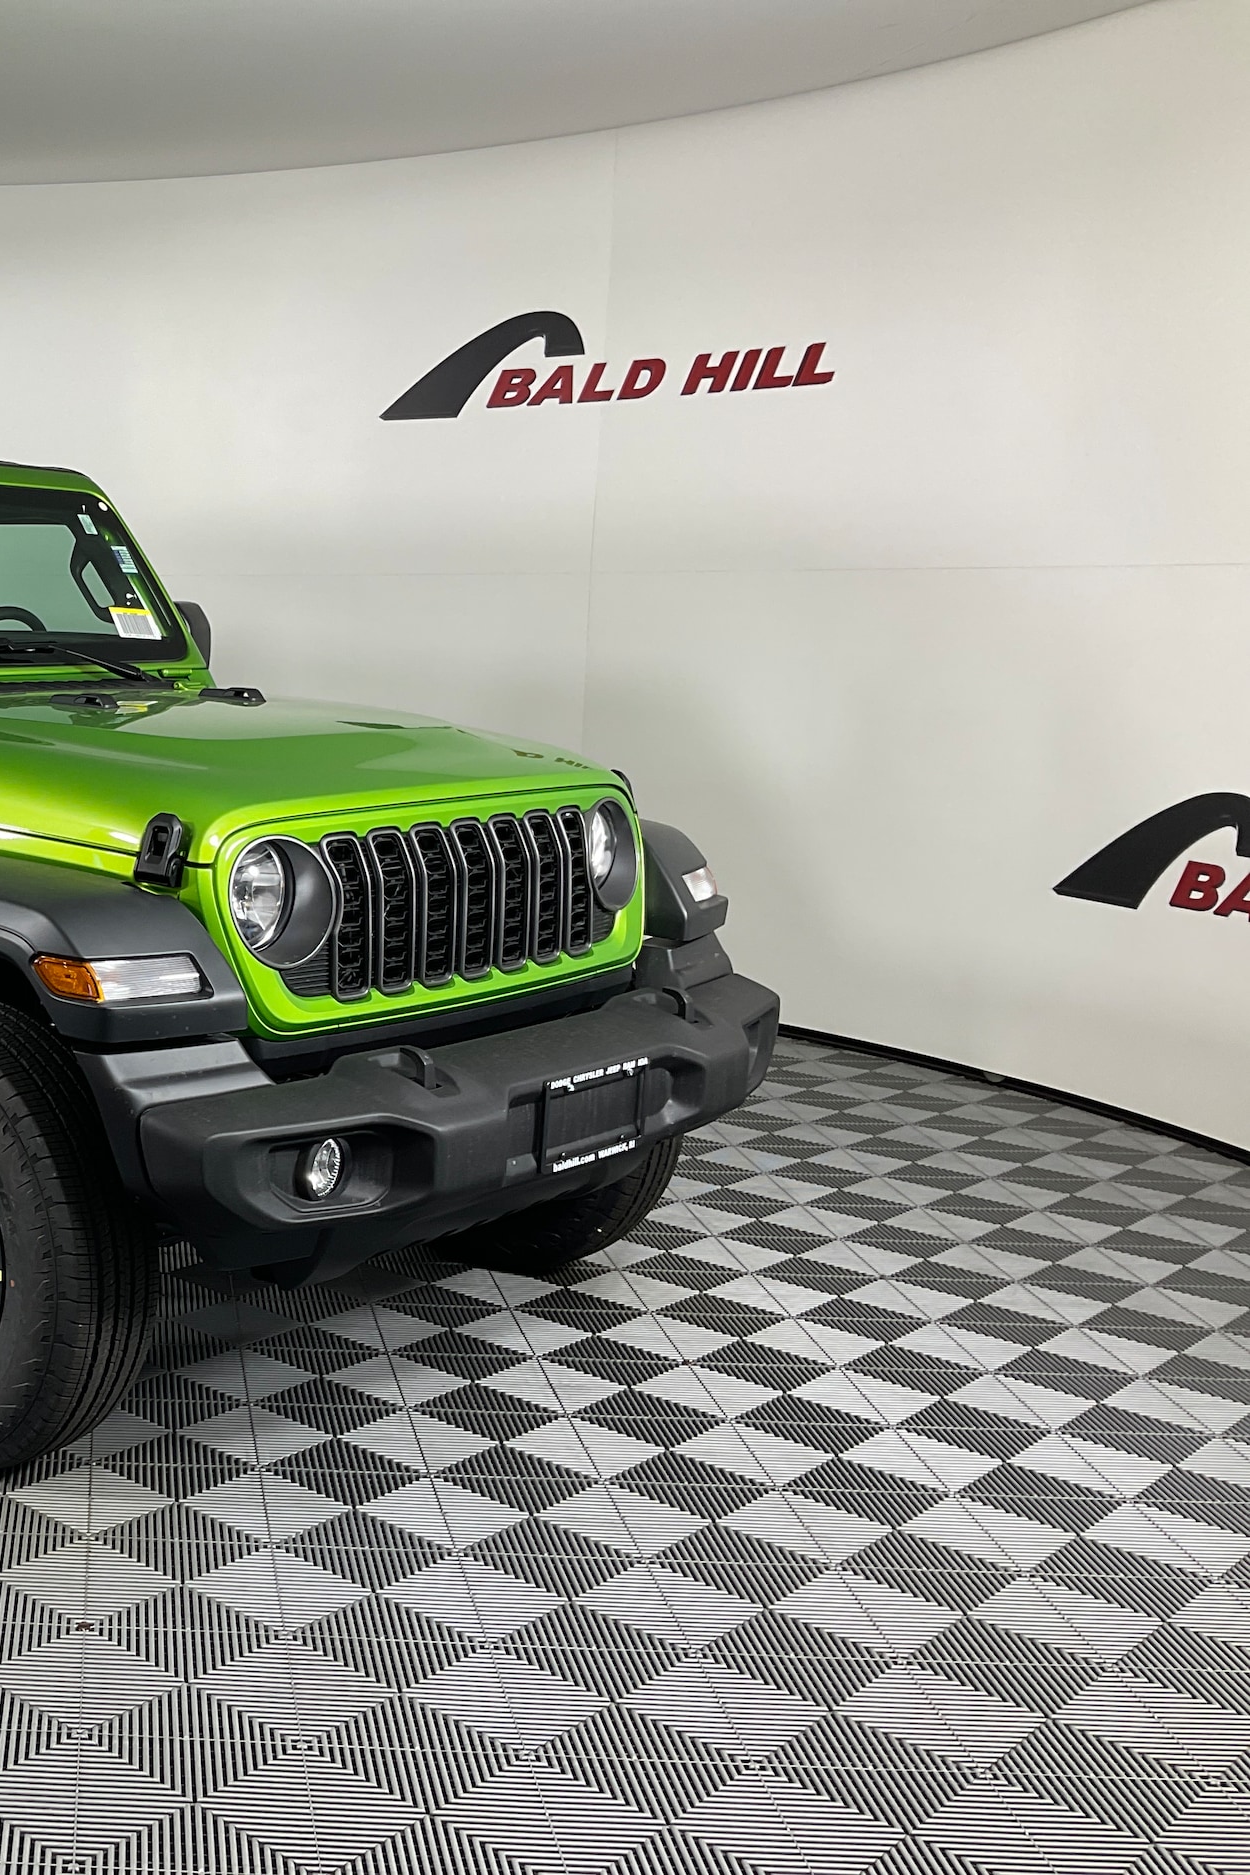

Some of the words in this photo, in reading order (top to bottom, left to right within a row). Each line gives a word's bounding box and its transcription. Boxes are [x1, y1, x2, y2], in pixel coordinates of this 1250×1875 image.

[486, 358, 666, 409] BALD
[680, 342, 836, 396] HILL
[573, 1068, 604, 1083] CHRYSLER
[606, 1064, 621, 1075] JEEP
[552, 1153, 596, 1173] baldhill.com
